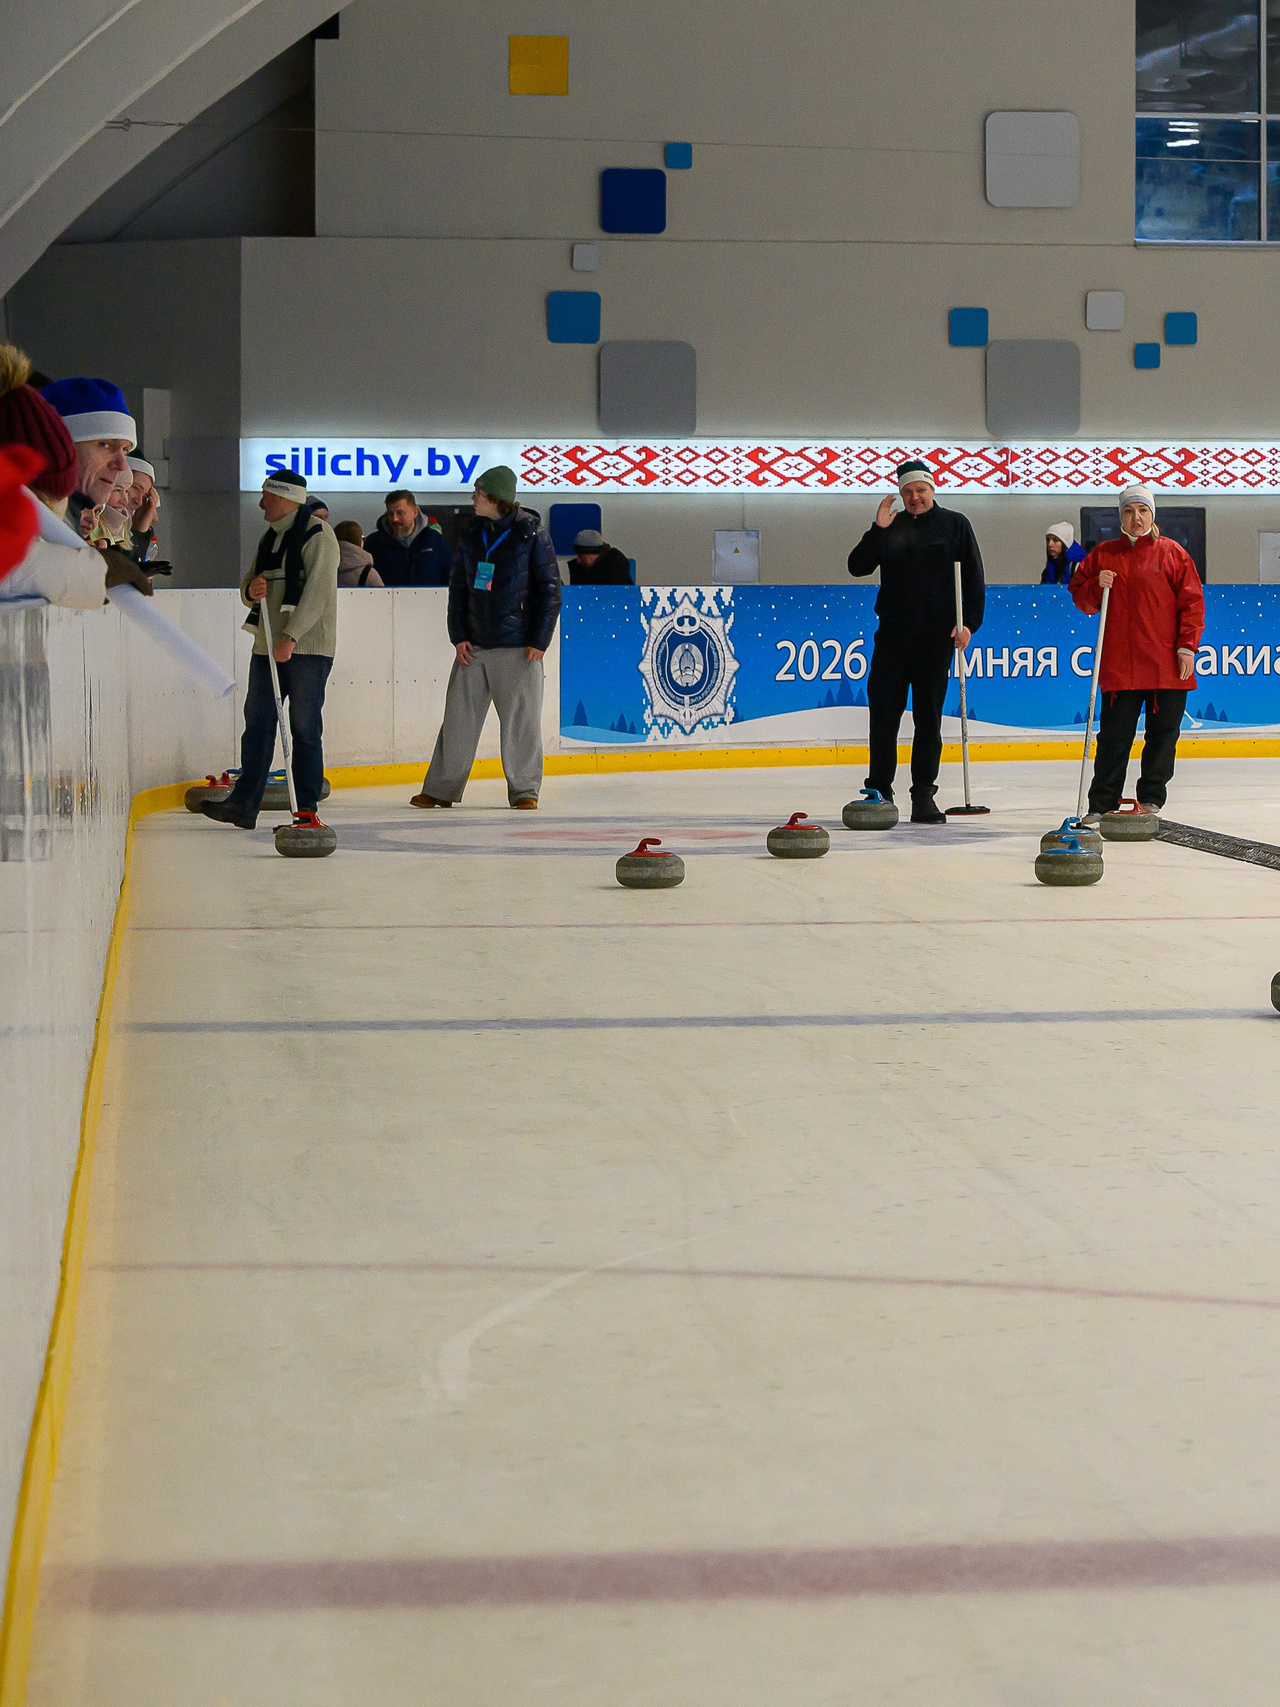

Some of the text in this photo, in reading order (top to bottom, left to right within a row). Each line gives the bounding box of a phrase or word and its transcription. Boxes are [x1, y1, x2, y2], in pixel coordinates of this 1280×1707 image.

[265, 447, 481, 483] silichy.by
[774, 638, 868, 681] 2026
[947, 647, 1059, 678] мняя
